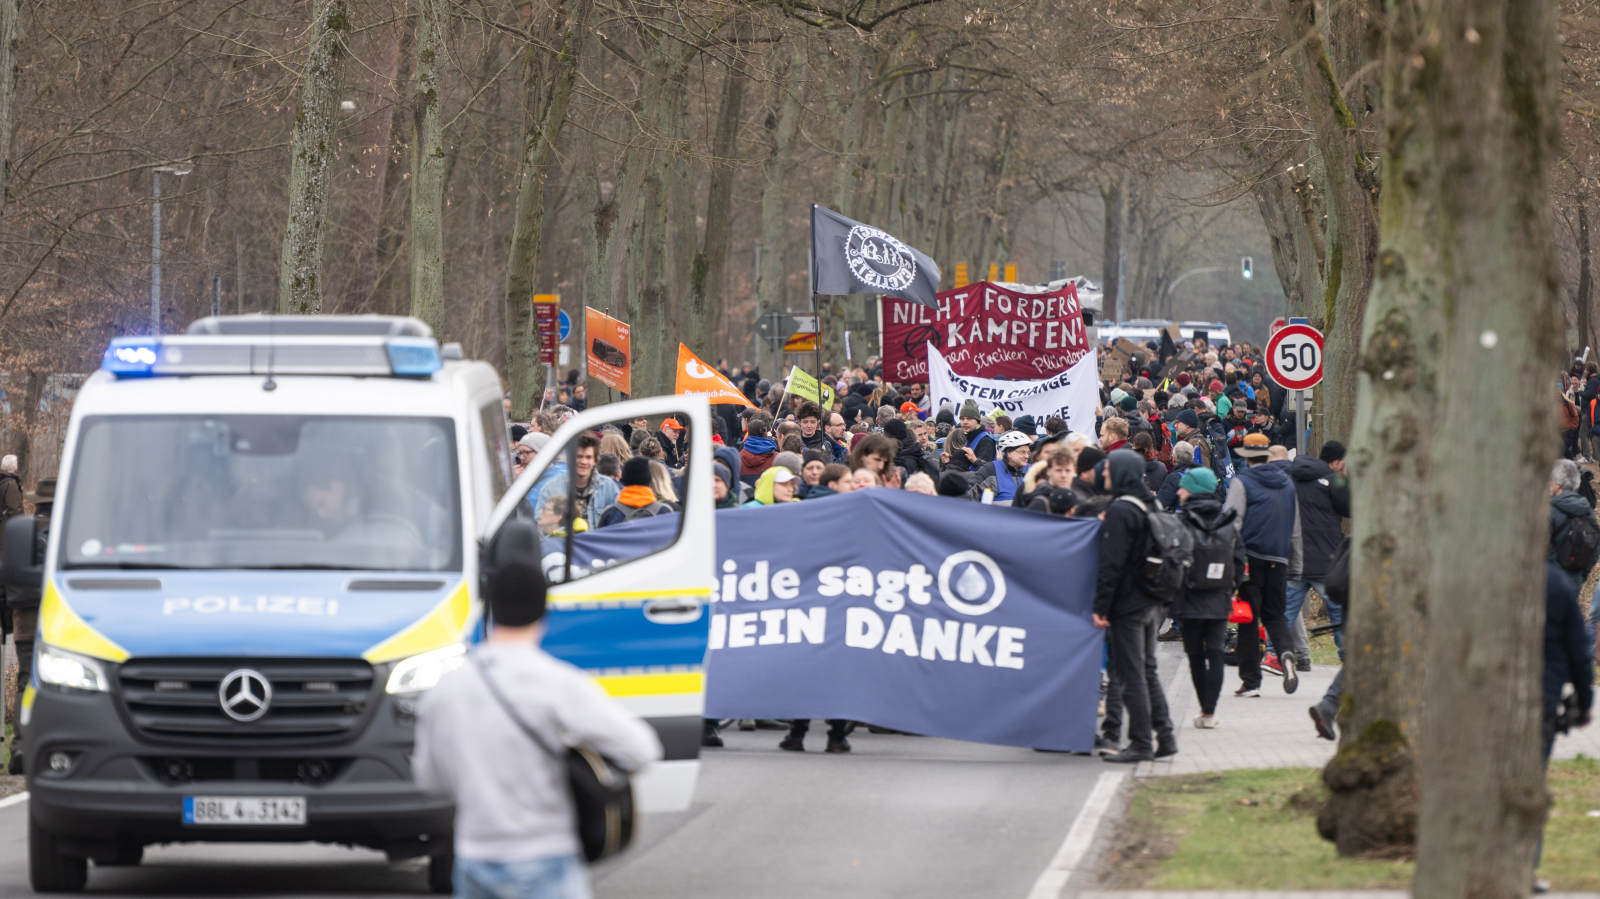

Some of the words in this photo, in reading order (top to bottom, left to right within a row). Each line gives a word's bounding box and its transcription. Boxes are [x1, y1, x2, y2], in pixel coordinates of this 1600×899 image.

[984, 287, 1078, 318] FORDERN
[947, 313, 1084, 349] KÄMPFEN!
[1281, 342, 1316, 372] 50
[992, 401, 1024, 412] NOT
[817, 563, 933, 612] sagt
[163, 595, 339, 617] POLIZEI
[845, 606, 1026, 670] DANKE
